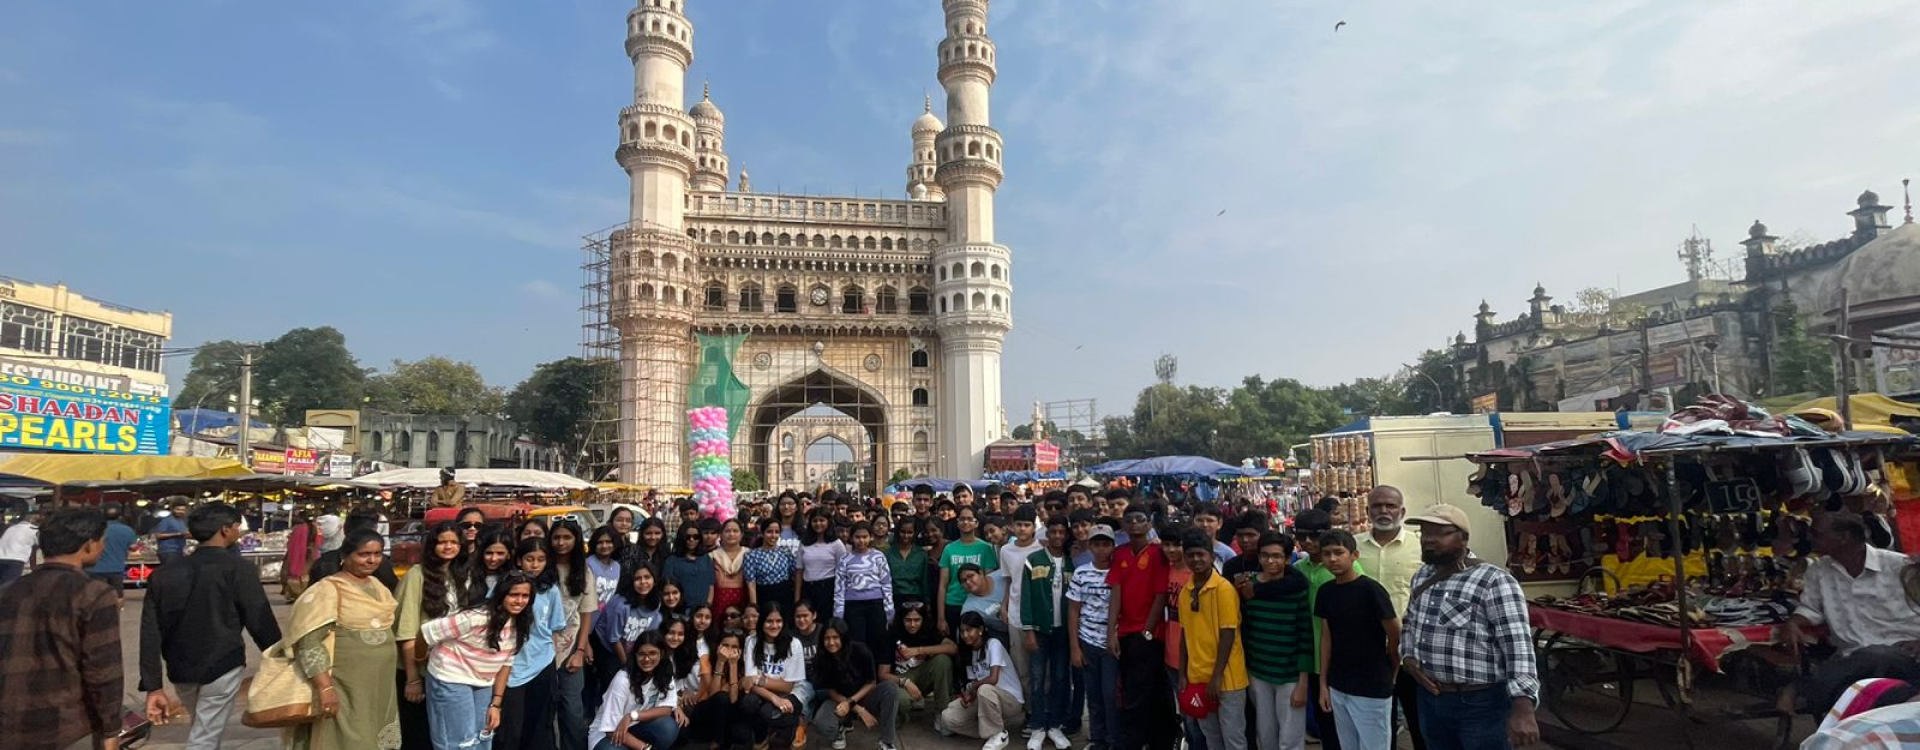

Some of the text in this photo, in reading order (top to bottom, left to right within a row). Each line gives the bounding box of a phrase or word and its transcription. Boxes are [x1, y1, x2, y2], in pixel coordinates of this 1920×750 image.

[0, 362, 122, 390] ESTAURANT
[40, 379, 161, 403] 9001:2015
[0, 393, 140, 425] SHAADAN
[0, 413, 138, 452] PEARLS
[951, 553, 982, 565] NEW YORK
